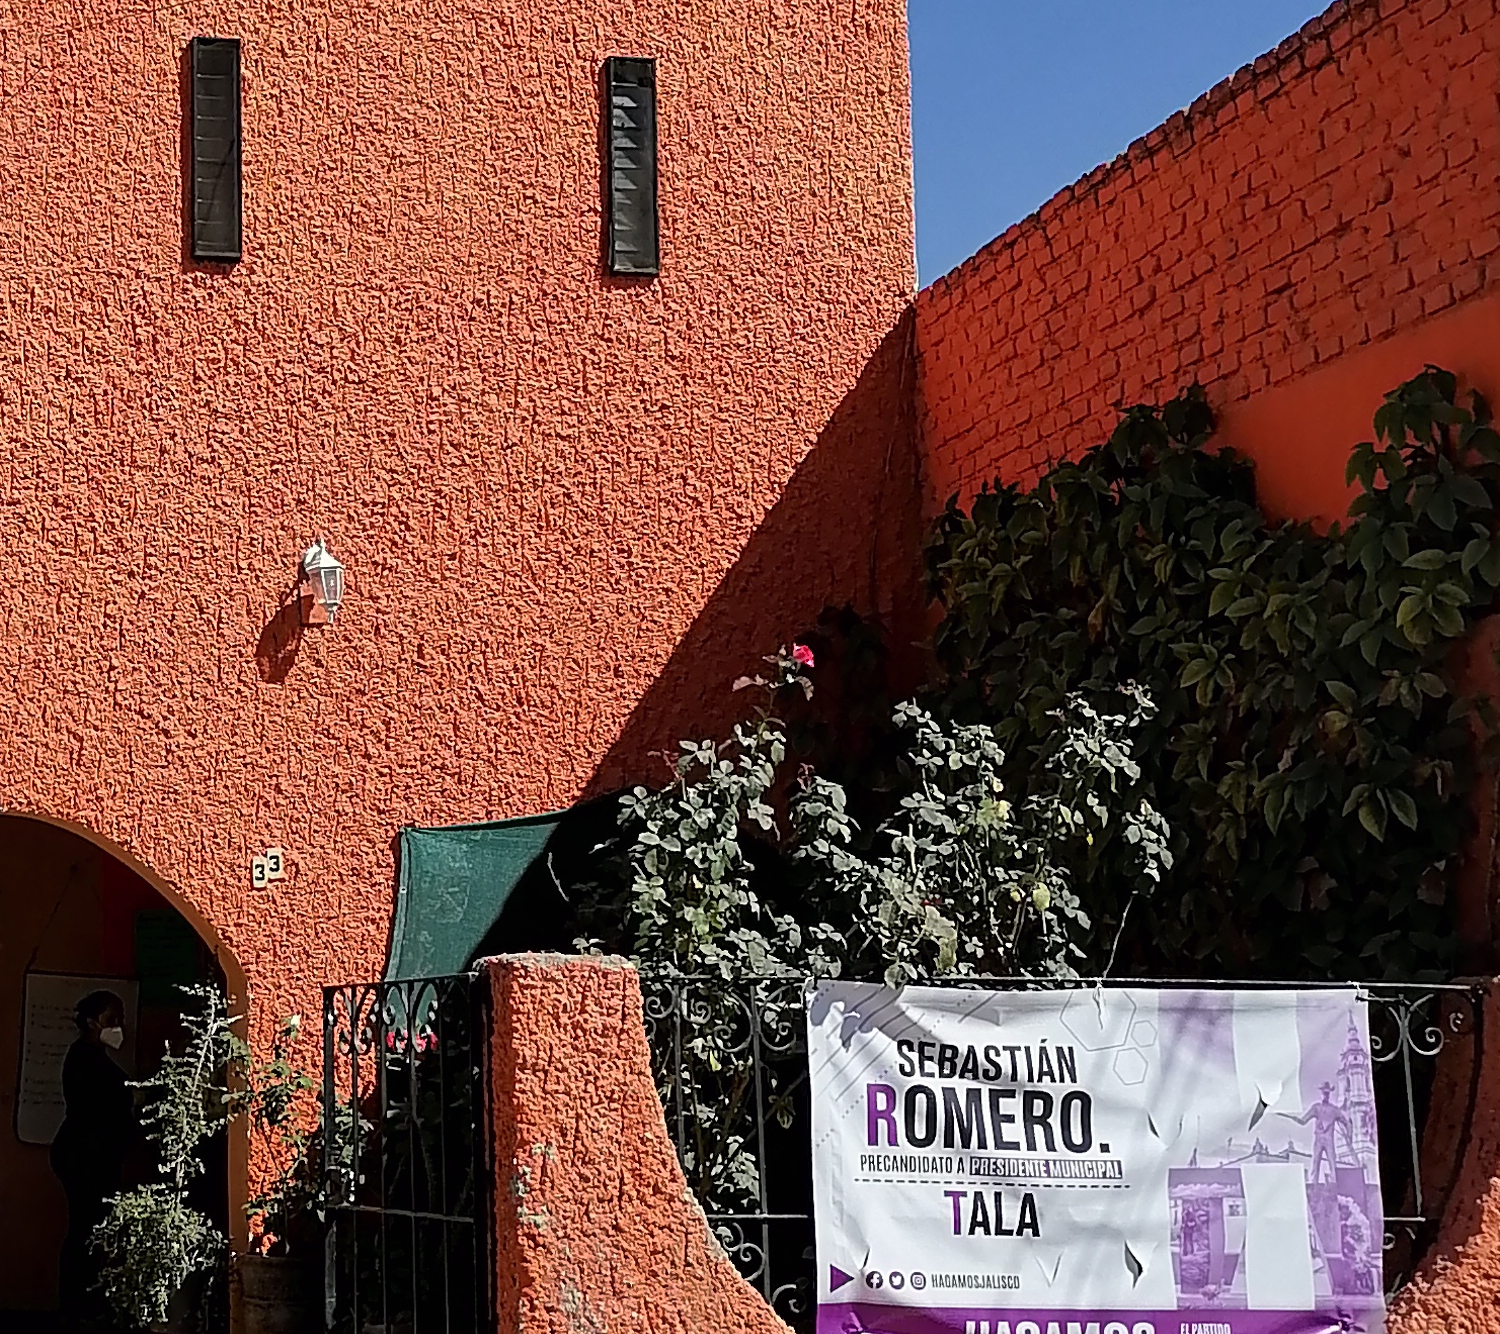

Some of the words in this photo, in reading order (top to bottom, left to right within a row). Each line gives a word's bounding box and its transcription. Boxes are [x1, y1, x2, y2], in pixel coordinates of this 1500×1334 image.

[254, 855, 280, 881] 33
[897, 1038, 1077, 1084] SEBASTIÁN
[866, 1083, 1111, 1153] ROMERO.
[860, 1154, 953, 1174] PRECANDIDATO
[956, 1157, 965, 1174] A
[971, 1157, 1048, 1178] PRESIDENTE
[1048, 1160, 1122, 1180] MUNICIPAL
[943, 1190, 1041, 1238] TALA
